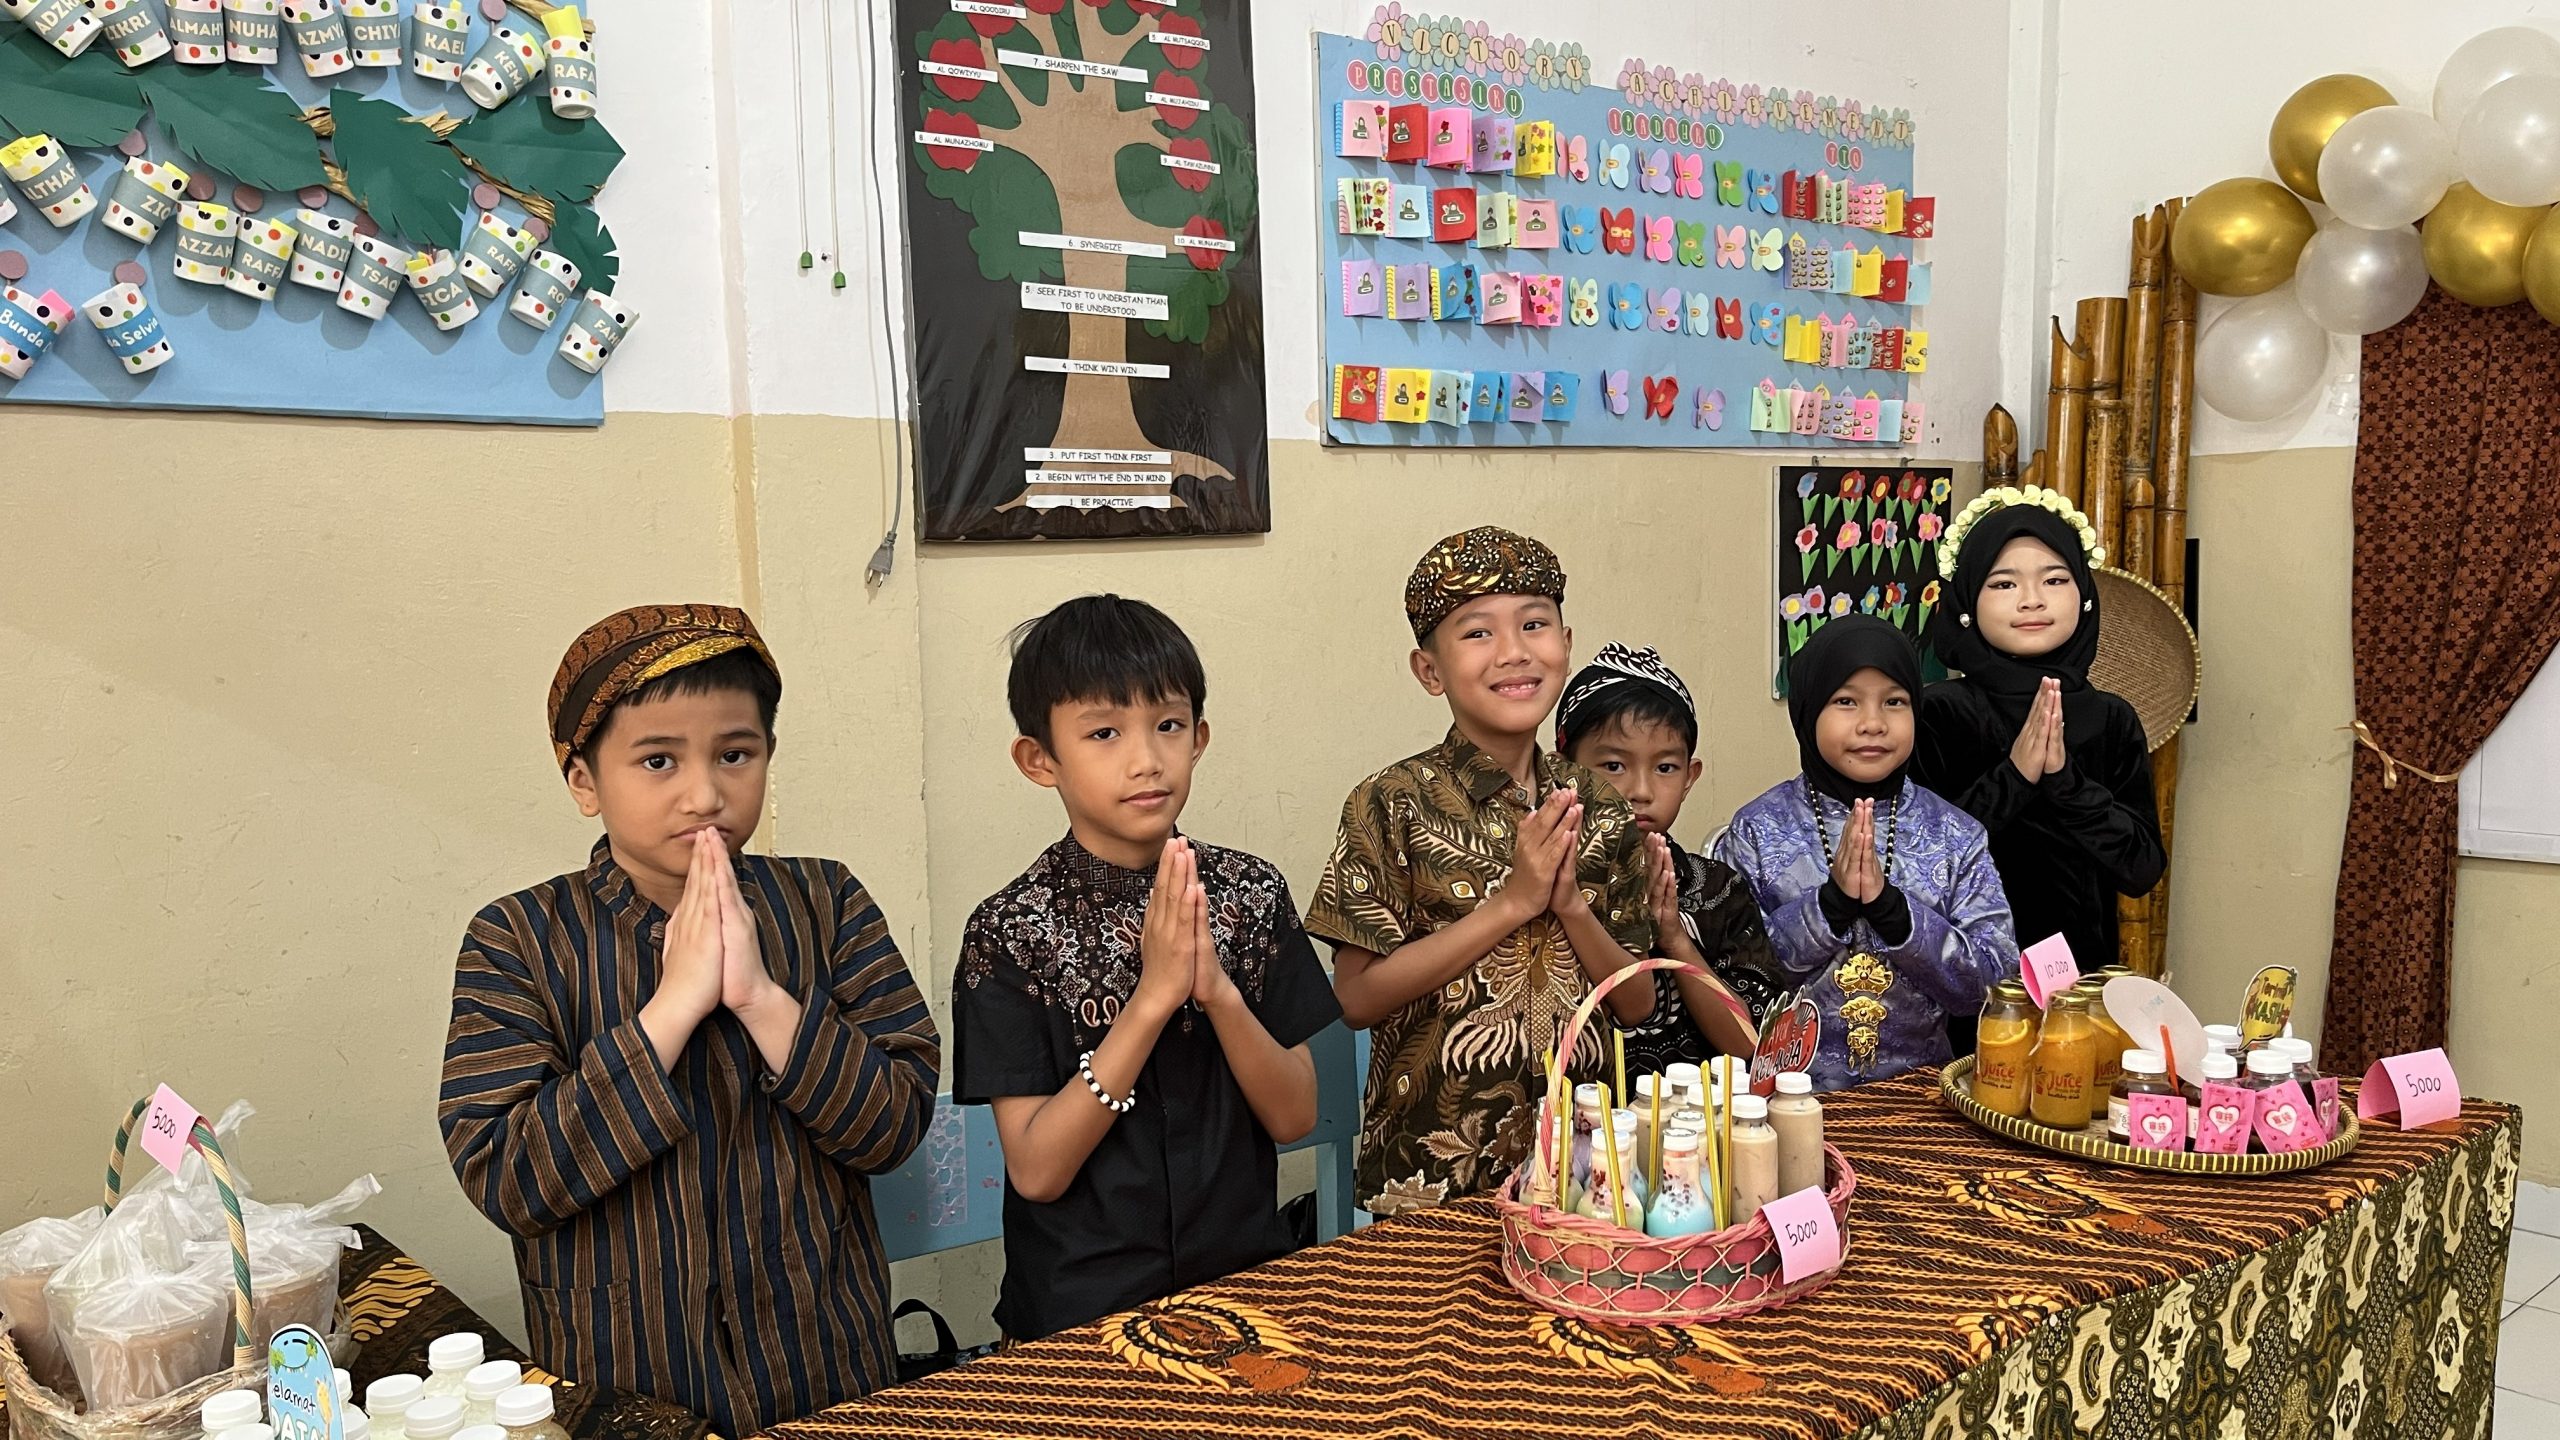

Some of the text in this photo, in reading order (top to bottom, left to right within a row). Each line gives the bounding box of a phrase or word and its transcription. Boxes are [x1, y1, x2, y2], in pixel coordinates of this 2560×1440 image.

[1045, 59, 1081, 72] SHARPEN
[1083, 64, 1098, 74] THE
[1101, 66, 1119, 77] SAW
[1354, 64, 1518, 112] PRESTASIKU
[1386, 23, 1906, 140] VICTORY ACHIEVEMENT
[1080, 240, 1122, 252] SYNERGIZE
[1037, 287, 1055, 296] SEEK
[1058, 289, 1081, 298] FIRST
[1085, 291, 1095, 300] TO
[1098, 293, 1144, 305] UNDERSTAN
[1146, 296, 1167, 306] THAN
[1060, 301, 1137, 316] TO BE UNDERSTOOD
[1074, 363, 1098, 372] THINK
[1101, 364, 1118, 373] WIN
[1121, 366, 1138, 374] WIN
[1061, 452, 1075, 460] PUT
[1079, 452, 1101, 461] FIRST
[1104, 452, 1128, 461] THINK
[1131, 453, 1152, 462] FIRST
[1047, 473, 1072, 482] BEGIN
[1075, 473, 1096, 482] WITH
[1099, 473, 1114, 482] THE
[1117, 474, 1132, 482] END
[1134, 474, 1144, 483] IN
[1146, 474, 1166, 483] MIND
[1081, 498, 1090, 506] BE
[1093, 498, 1134, 507] PROACTIVE
[2047, 1070, 2083, 1092] Juice
[2405, 1073, 2442, 1098] 5000
[151, 1106, 177, 1139] 5000
[1784, 1219, 1818, 1248] 5000
[273, 1379, 317, 1417] elamat
